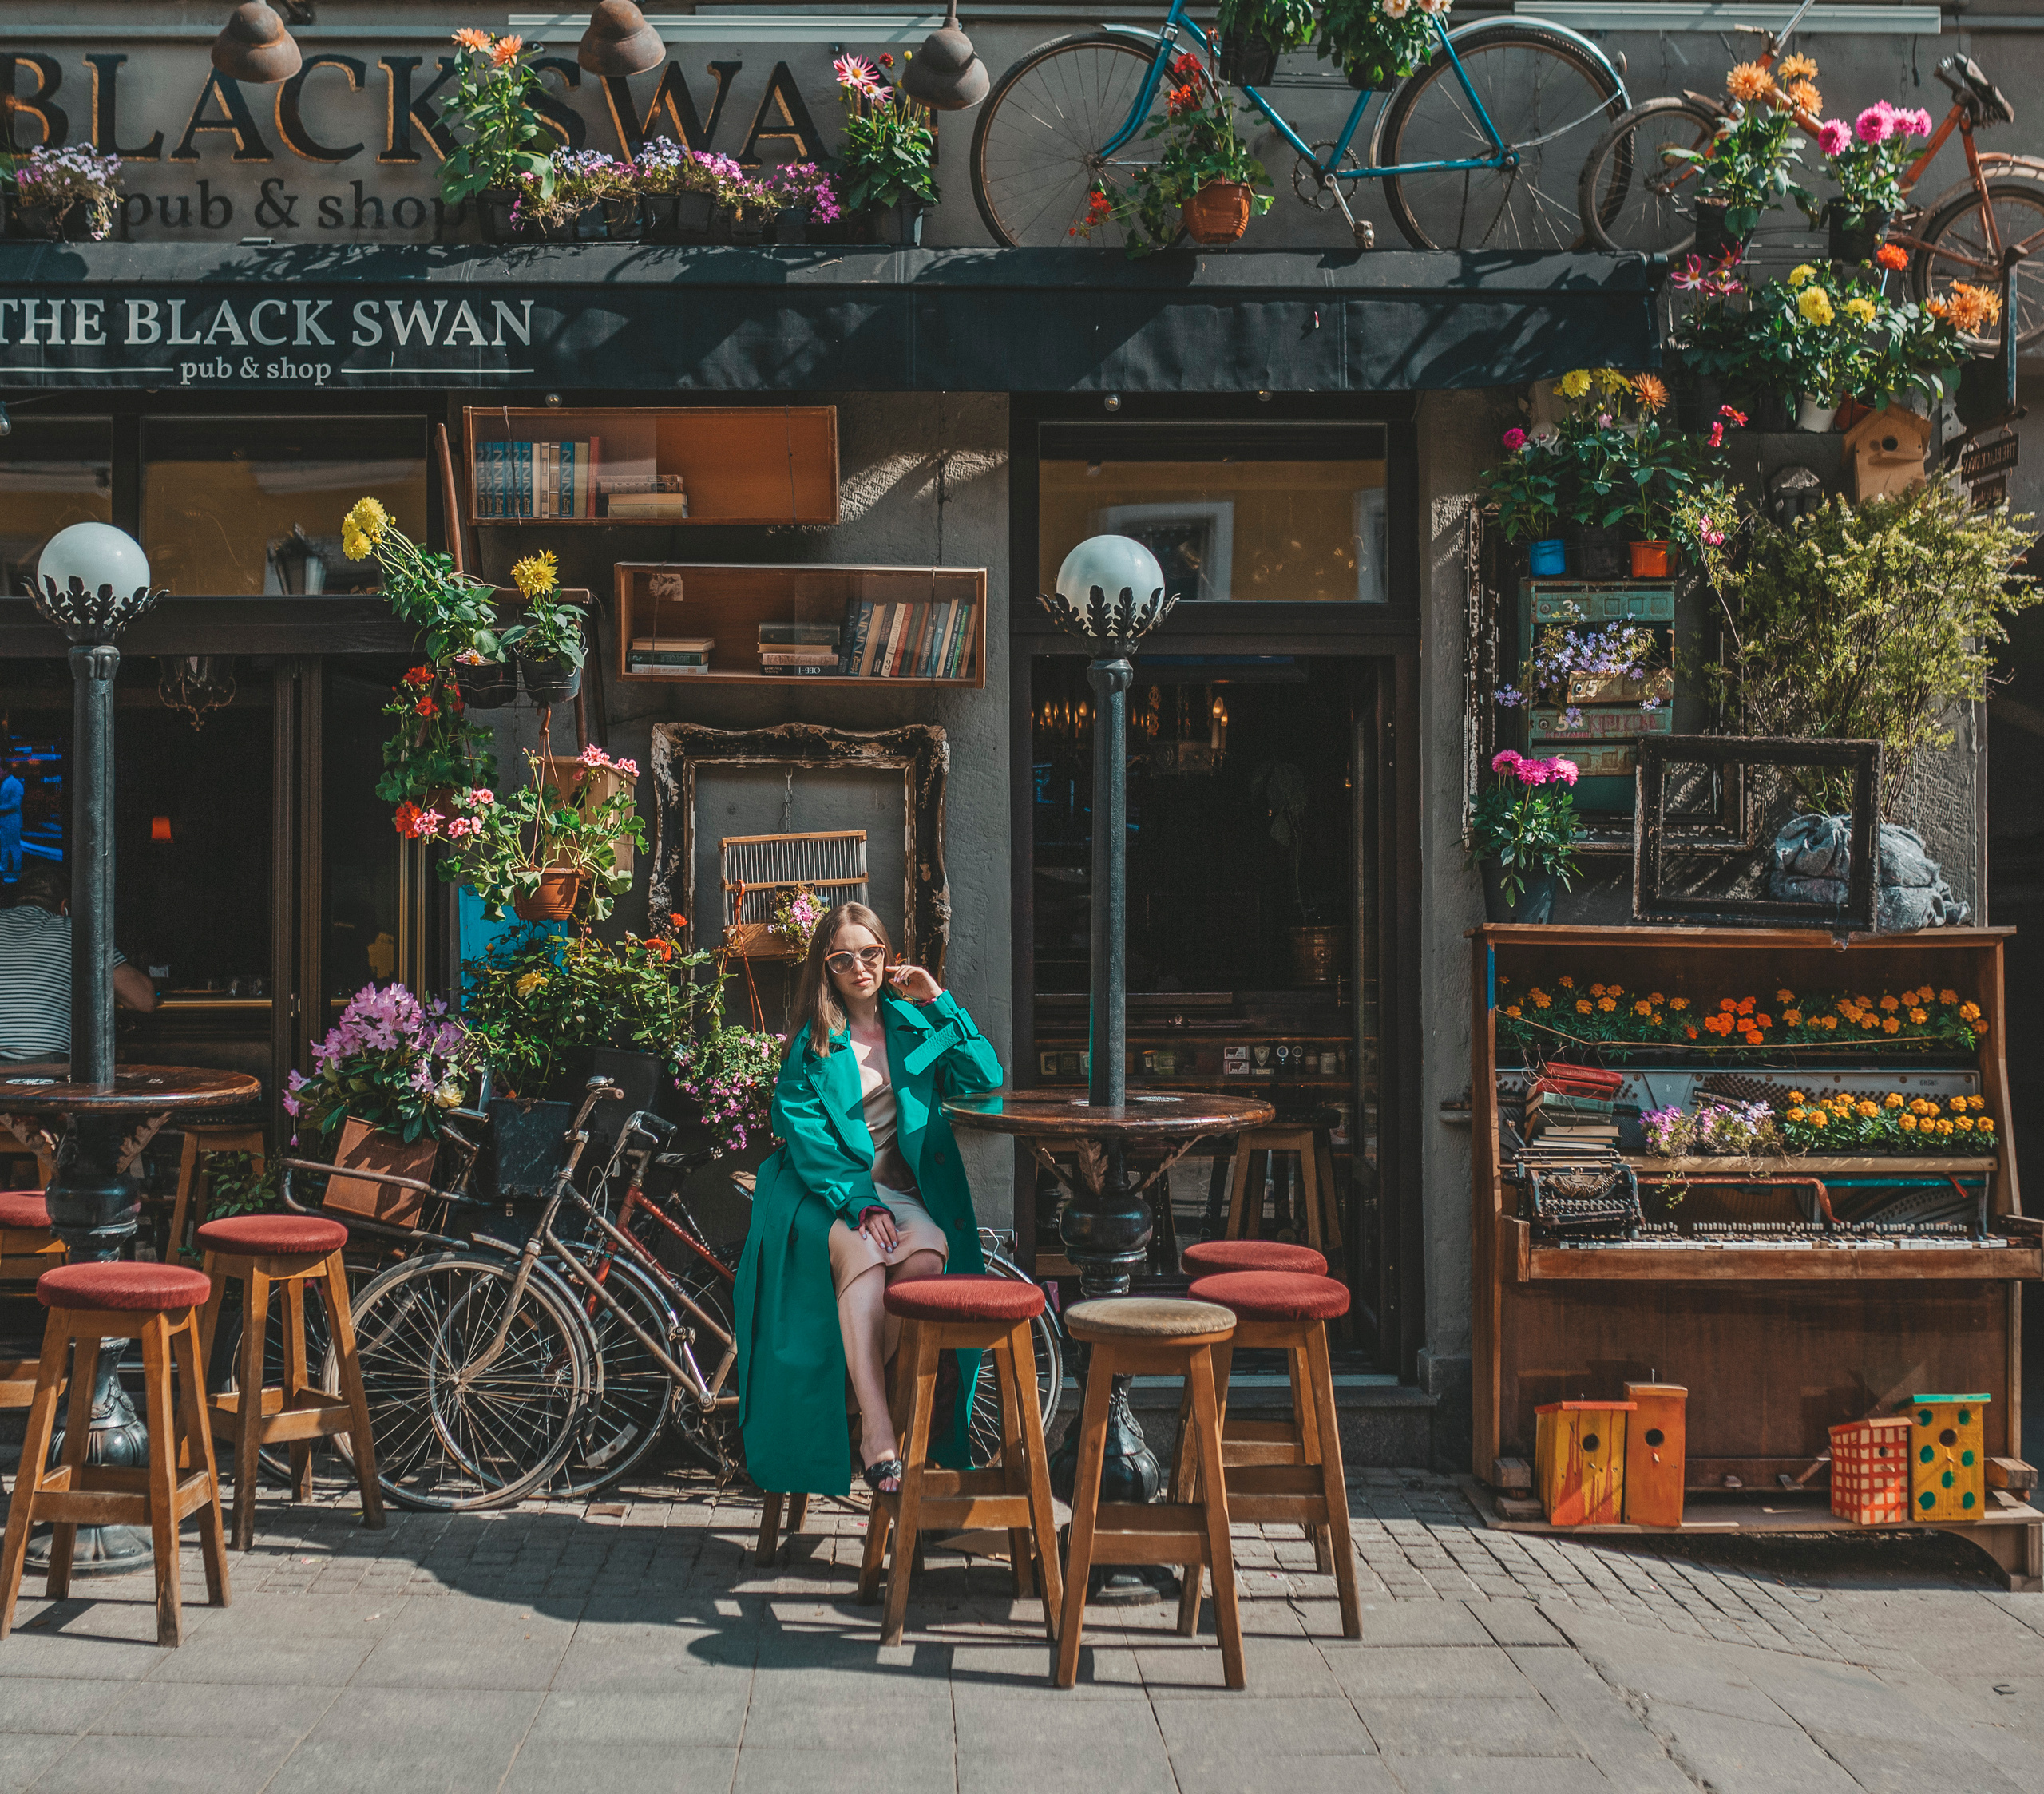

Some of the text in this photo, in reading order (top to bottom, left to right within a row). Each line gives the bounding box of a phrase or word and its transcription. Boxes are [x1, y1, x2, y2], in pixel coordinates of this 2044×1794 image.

[0, 52, 465, 164] BLACK
[121, 178, 466, 240] pub & shop
[0, 299, 534, 347] THE BLACK SWAN
[180, 356, 331, 386] pub & shop
[1563, 600, 1574, 616] 3
